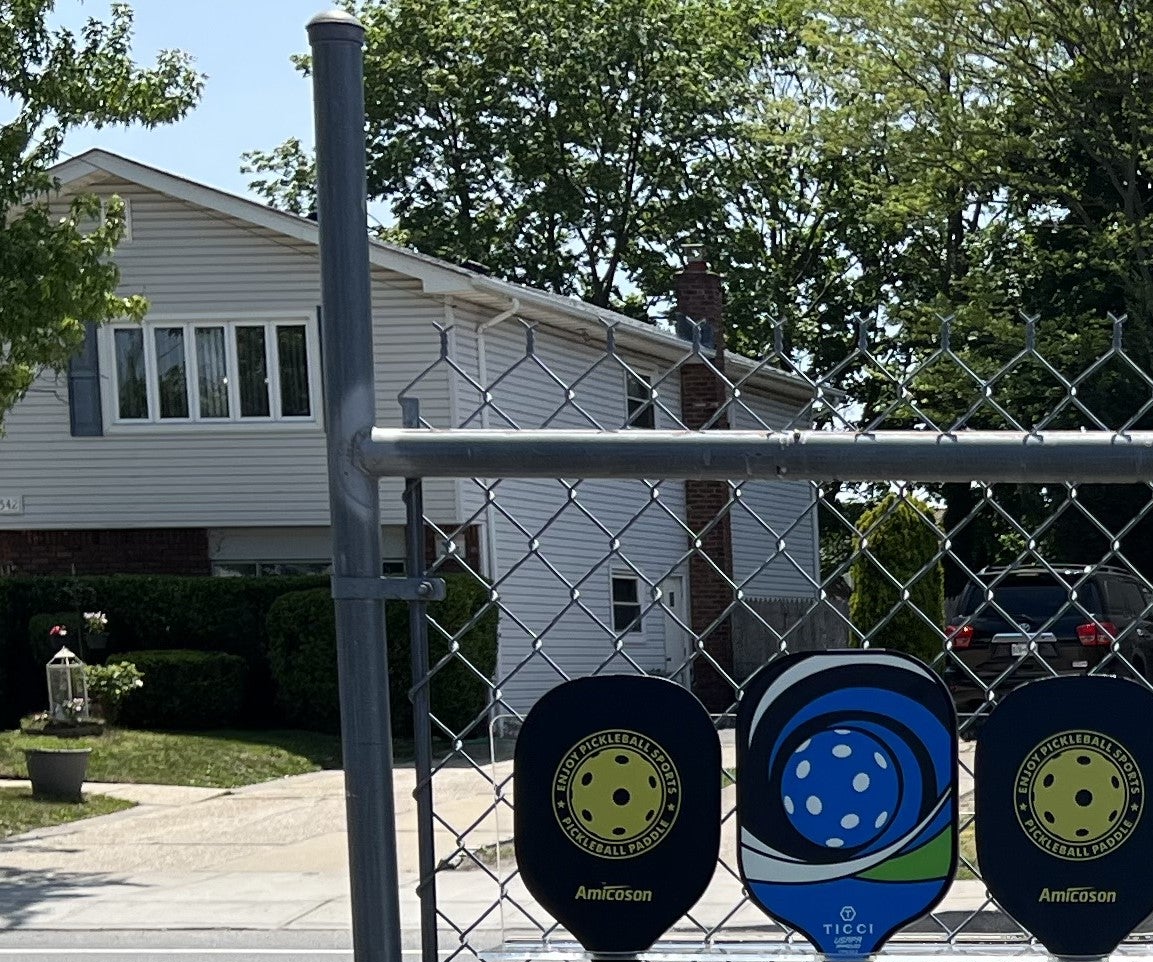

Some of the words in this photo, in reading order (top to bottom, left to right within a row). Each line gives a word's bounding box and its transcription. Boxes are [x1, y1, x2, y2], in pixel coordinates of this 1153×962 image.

[556, 752, 580, 791] ENJOY
[579, 733, 650, 755] PICKLEBALL
[651, 749, 677, 795] SPORTS
[1018, 754, 1041, 794] ENJOY
[1040, 734, 1112, 756] PICKLEBALL
[1113, 750, 1140, 795] SPORTS
[562, 817, 626, 856] PICKLEBALL
[628, 821, 670, 854] PADDLE
[1025, 820, 1089, 857] PICKLEBALL
[1092, 820, 1133, 855] PADDLE
[575, 885, 652, 902] Amicoson
[1039, 886, 1116, 903] Amicoson
[823, 924, 873, 934] TICCI
